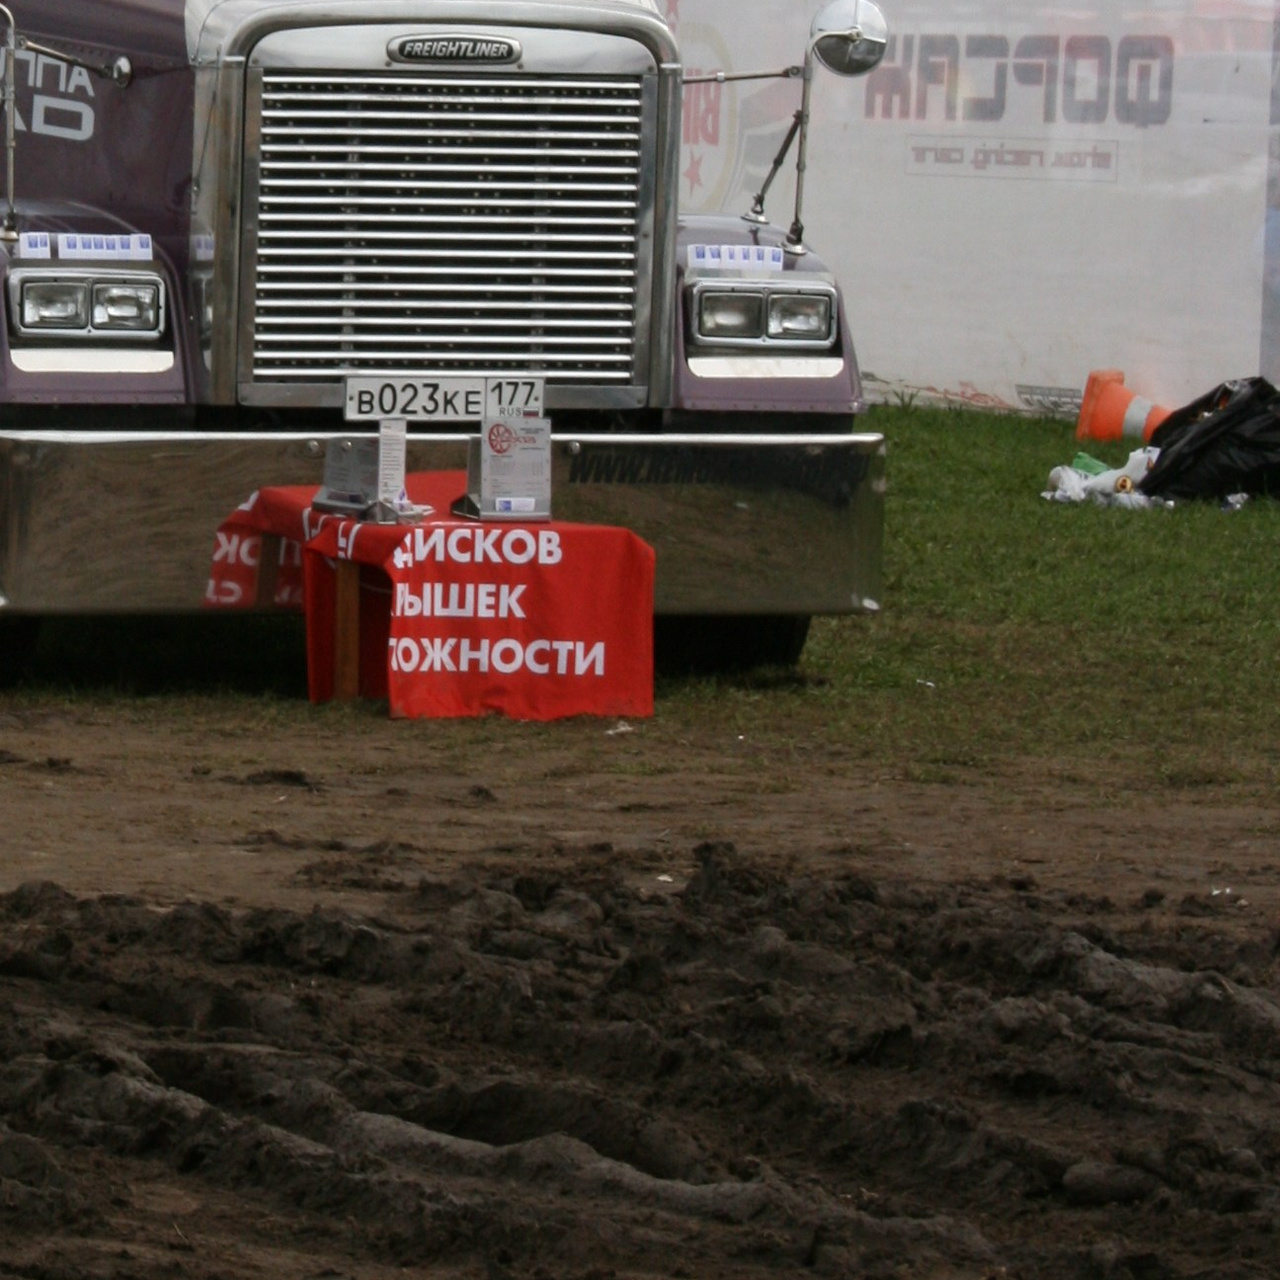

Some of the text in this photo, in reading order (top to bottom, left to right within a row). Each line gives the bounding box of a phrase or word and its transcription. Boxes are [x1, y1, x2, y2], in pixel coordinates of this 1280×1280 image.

[404, 40, 509, 58] FREIGHTLINER
[357, 381, 536, 416] В023КЕ 177
[497, 407, 523, 417] RUS
